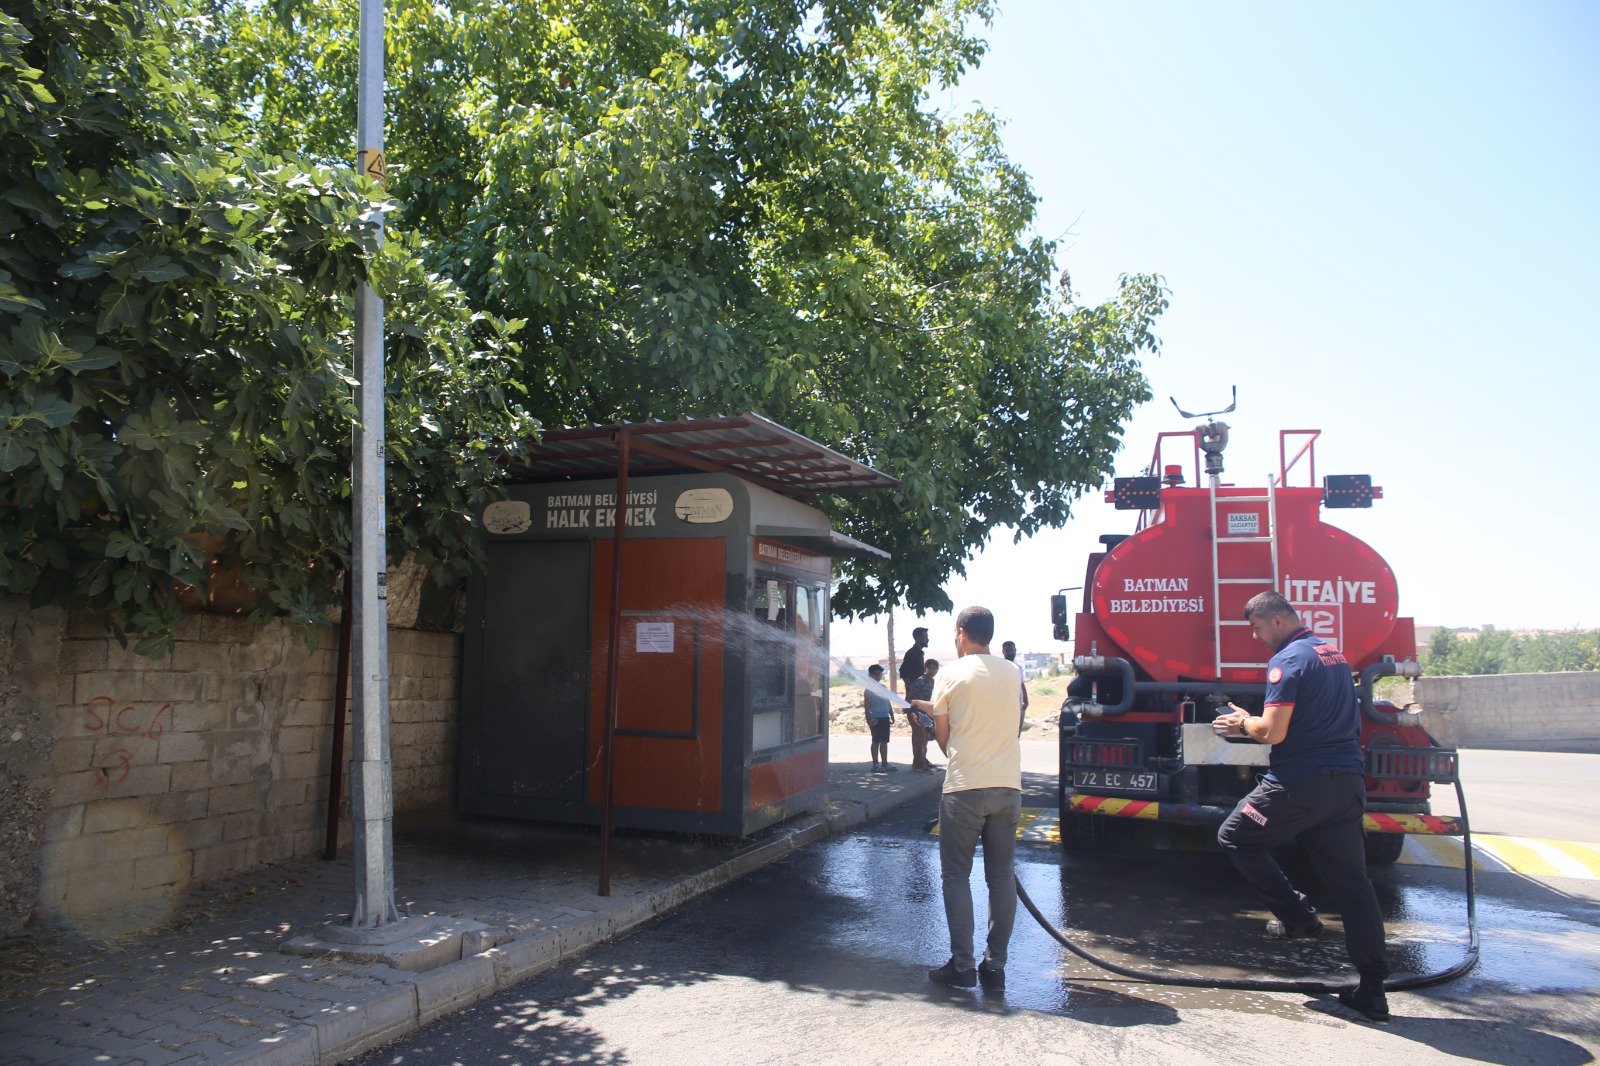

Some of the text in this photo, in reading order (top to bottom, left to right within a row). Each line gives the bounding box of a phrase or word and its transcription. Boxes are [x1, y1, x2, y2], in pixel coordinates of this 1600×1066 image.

[547, 494, 592, 508] BATMAN
[546, 508, 591, 529] HALK
[1230, 514, 1257, 522] BAKSAN
[758, 542, 778, 559] BATMAN
[1123, 578, 1189, 593] BATMAN
[1284, 573, 1377, 604] İTFAİYE
[1110, 595, 1205, 613] BELEDİYESİ
[1081, 772, 1154, 788] 72 EC 457
